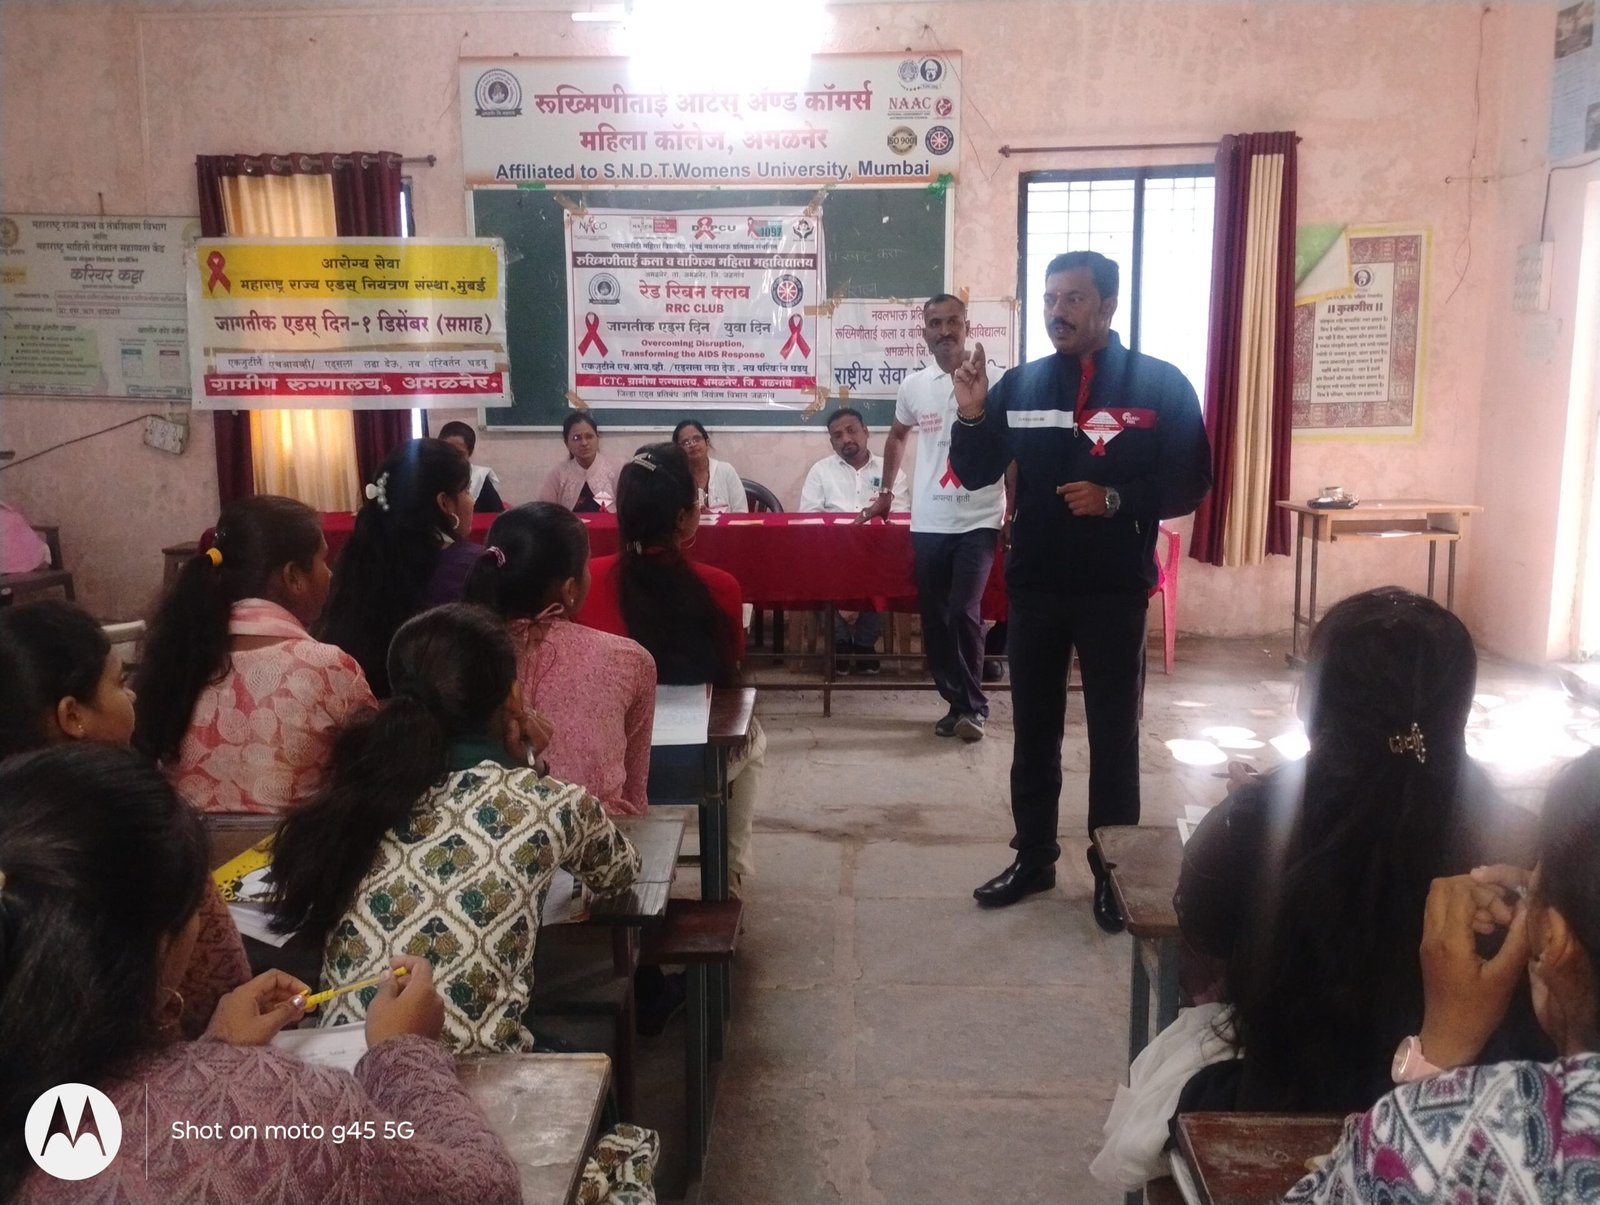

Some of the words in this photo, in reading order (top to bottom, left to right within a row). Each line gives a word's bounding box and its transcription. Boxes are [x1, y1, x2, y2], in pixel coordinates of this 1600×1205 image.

[804, 80, 873, 111] कॉमर्स
[889, 97, 931, 110] NAAC
[579, 122, 647, 152] महिला
[743, 121, 829, 149] अमळनेर
[496, 164, 575, 179] Affiliated
[581, 166, 598, 179] to
[757, 160, 852, 180] University,
[858, 159, 930, 176] Mumbai
[759, 226, 782, 238] 1097
[322, 255, 369, 269] आरोग्य
[373, 255, 401, 269] सेवा
[640, 256, 664, 268] कला
[666, 256, 674, 268] व
[676, 253, 716, 268] वाणिज्य
[718, 254, 751, 269] महिला
[753, 254, 814, 269] महाविद्यालय
[71, 263, 114, 283] करियर
[118, 269, 144, 284] कट्टा
[240, 279, 285, 293] महाराष्ट्र
[288, 279, 320, 290] राज्य
[324, 279, 360, 294] एडस्
[361, 275, 409, 291] नियंत्रण
[639, 279, 661, 299] रेड
[665, 280, 706, 299] रिबन
[711, 285, 750, 299] क्लब
[665, 303, 690, 313] RRC
[694, 303, 724, 313] CLUB
[872, 310, 908, 321] नवलभाऊ
[214, 309, 276, 331] जागतीक
[282, 315, 320, 339] एडस्
[376, 308, 430, 332] डिसेंबर
[436, 313, 492, 335] (सप्ताह)
[606, 319, 656, 333] जागतीक
[658, 321, 686, 334] एड्स
[689, 319, 711, 334] दिन
[724, 322, 746, 337] युवा
[750, 319, 772, 336] दिन
[880, 328, 897, 339] कला
[900, 328, 906, 339] व
[969, 323, 1007, 339] हाविद्यालय
[641, 340, 694, 349] Overcoming
[696, 340, 745, 349] Disruption,
[885, 342, 914, 357] अमळनेर
[228, 356, 263, 370] एकजुटीने
[408, 359, 420, 368] नव
[428, 356, 461, 368] परिवर्तन
[467, 358, 488, 370] घडवू
[621, 350, 680, 359] Transforming
[682, 350, 695, 358] the
[697, 350, 719, 358] AIDS
[721, 350, 765, 360] Response
[743, 364, 755, 373] नव
[834, 361, 873, 390] राष्ट्रीय
[879, 361, 907, 385] सेवा
[210, 373, 278, 392] ग्रामीण
[627, 375, 657, 387] ग्रामीण
